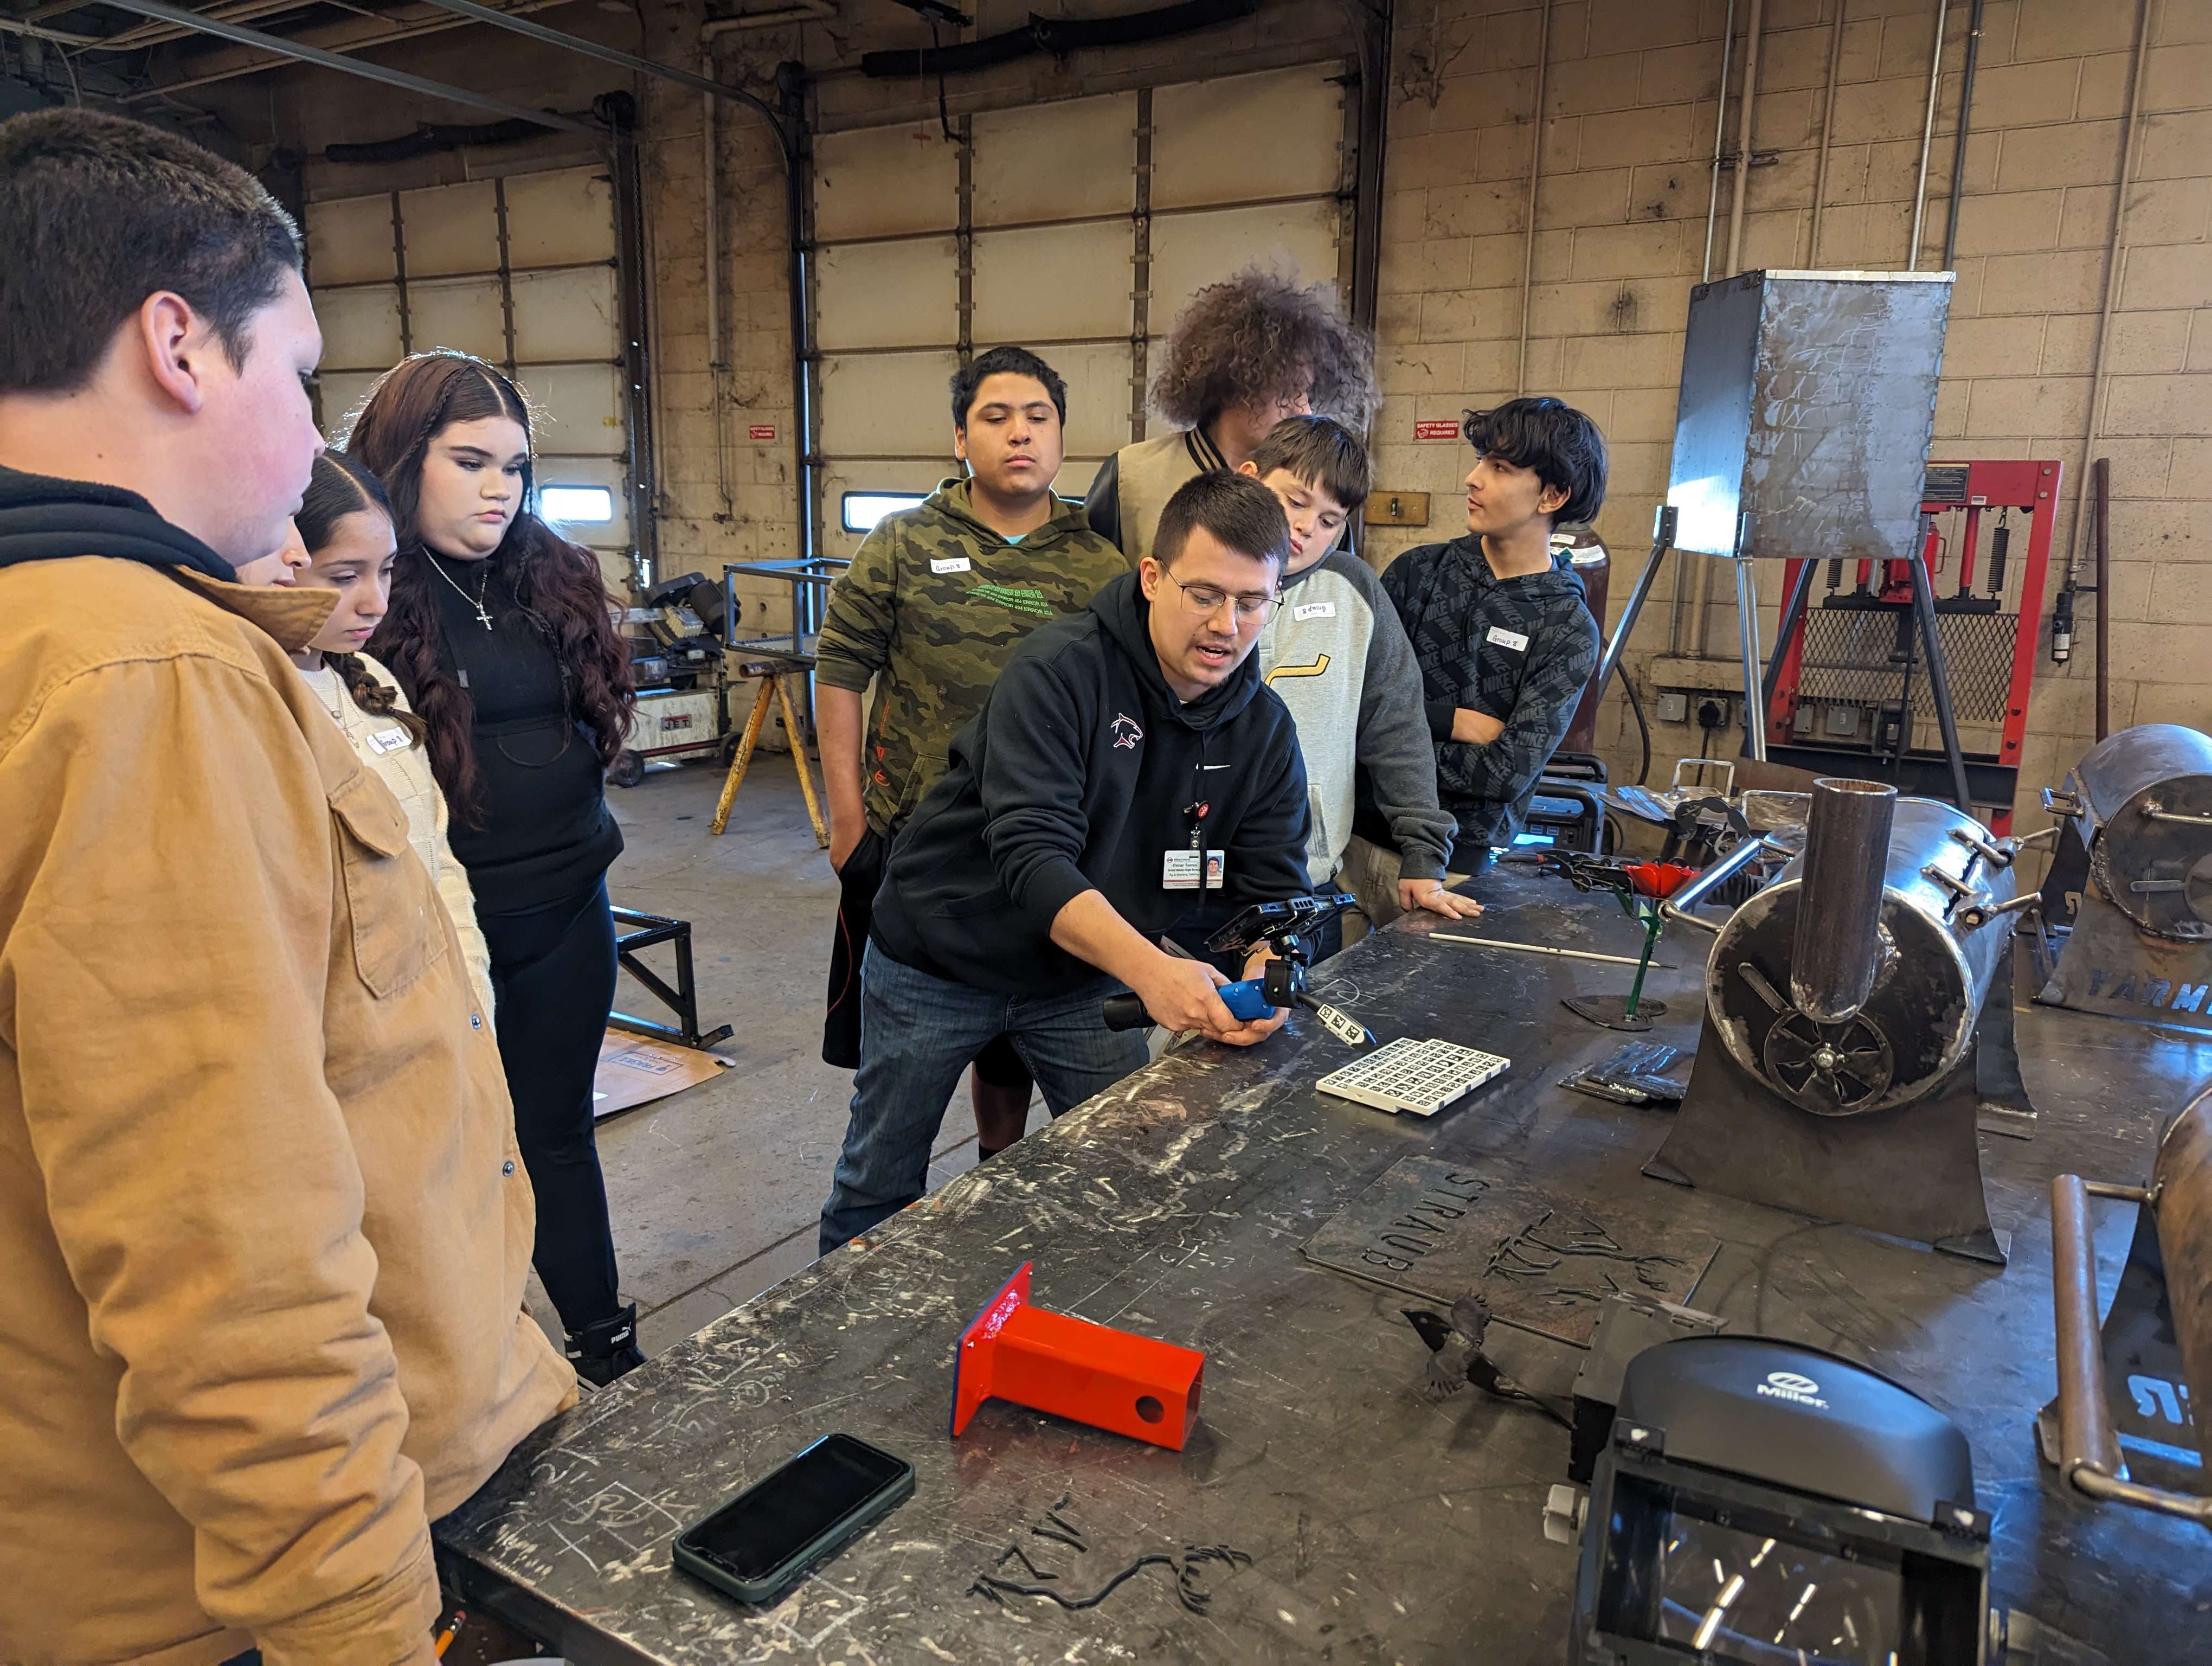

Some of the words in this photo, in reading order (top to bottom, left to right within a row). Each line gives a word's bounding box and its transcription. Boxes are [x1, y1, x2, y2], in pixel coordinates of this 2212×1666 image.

[1493, 635, 1511, 645] Group
[1483, 672, 1512, 695] NIKE
[665, 720, 689, 729] JET
[1515, 731, 1546, 749] NIKE
[2088, 969, 2212, 1016] FARM
[1361, 1172, 1490, 1272] STRAUB
[611, 1329, 629, 1344] PUMA
[1757, 1384, 1828, 1409] Miller
